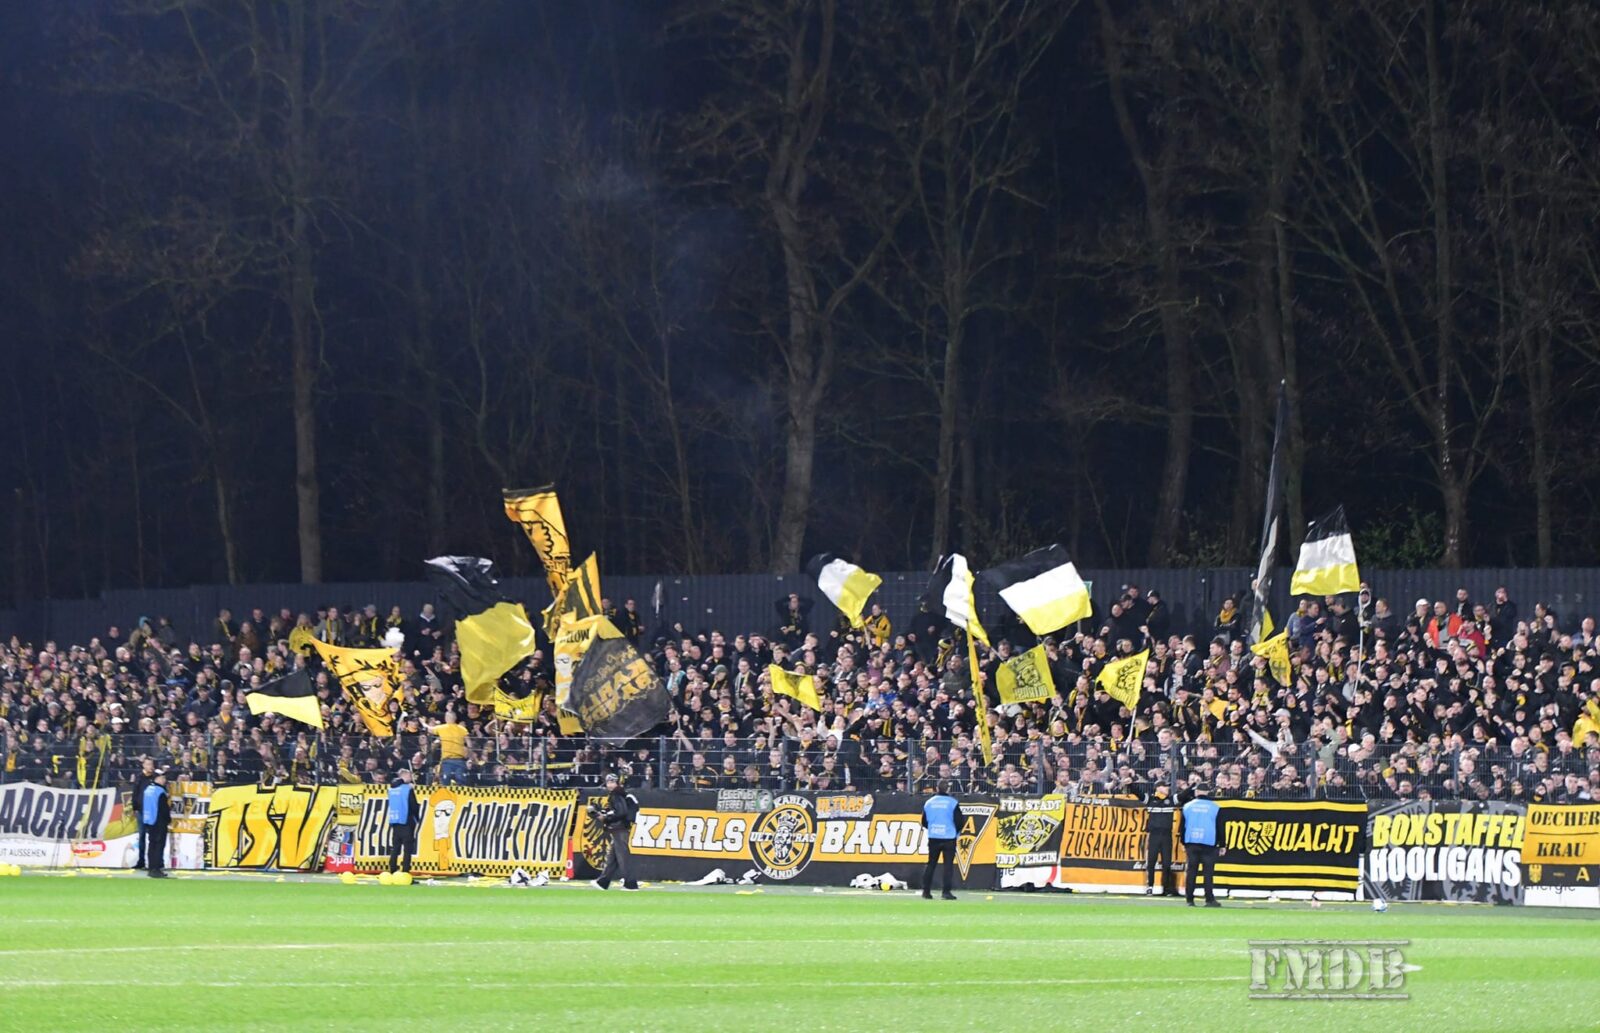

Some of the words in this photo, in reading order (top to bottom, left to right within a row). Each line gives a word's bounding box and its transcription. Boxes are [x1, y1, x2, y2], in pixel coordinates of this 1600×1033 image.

[773, 795, 809, 809] KARLS
[1000, 796, 1023, 811] FÜR
[1025, 799, 1062, 811] STADT
[0, 787, 108, 840] AACHEN
[1531, 810, 1600, 827] OECHER
[208, 784, 338, 868] TSV
[454, 801, 572, 862] CONNECTION
[631, 813, 747, 852] KARLS
[9, 848, 47, 857] AUSSEHEN
[1536, 842, 1588, 858] KRAU
[1019, 853, 1057, 865] VEREIN
[1369, 847, 1522, 887] HOOLIGANS
[763, 866, 800, 879] BANDE
